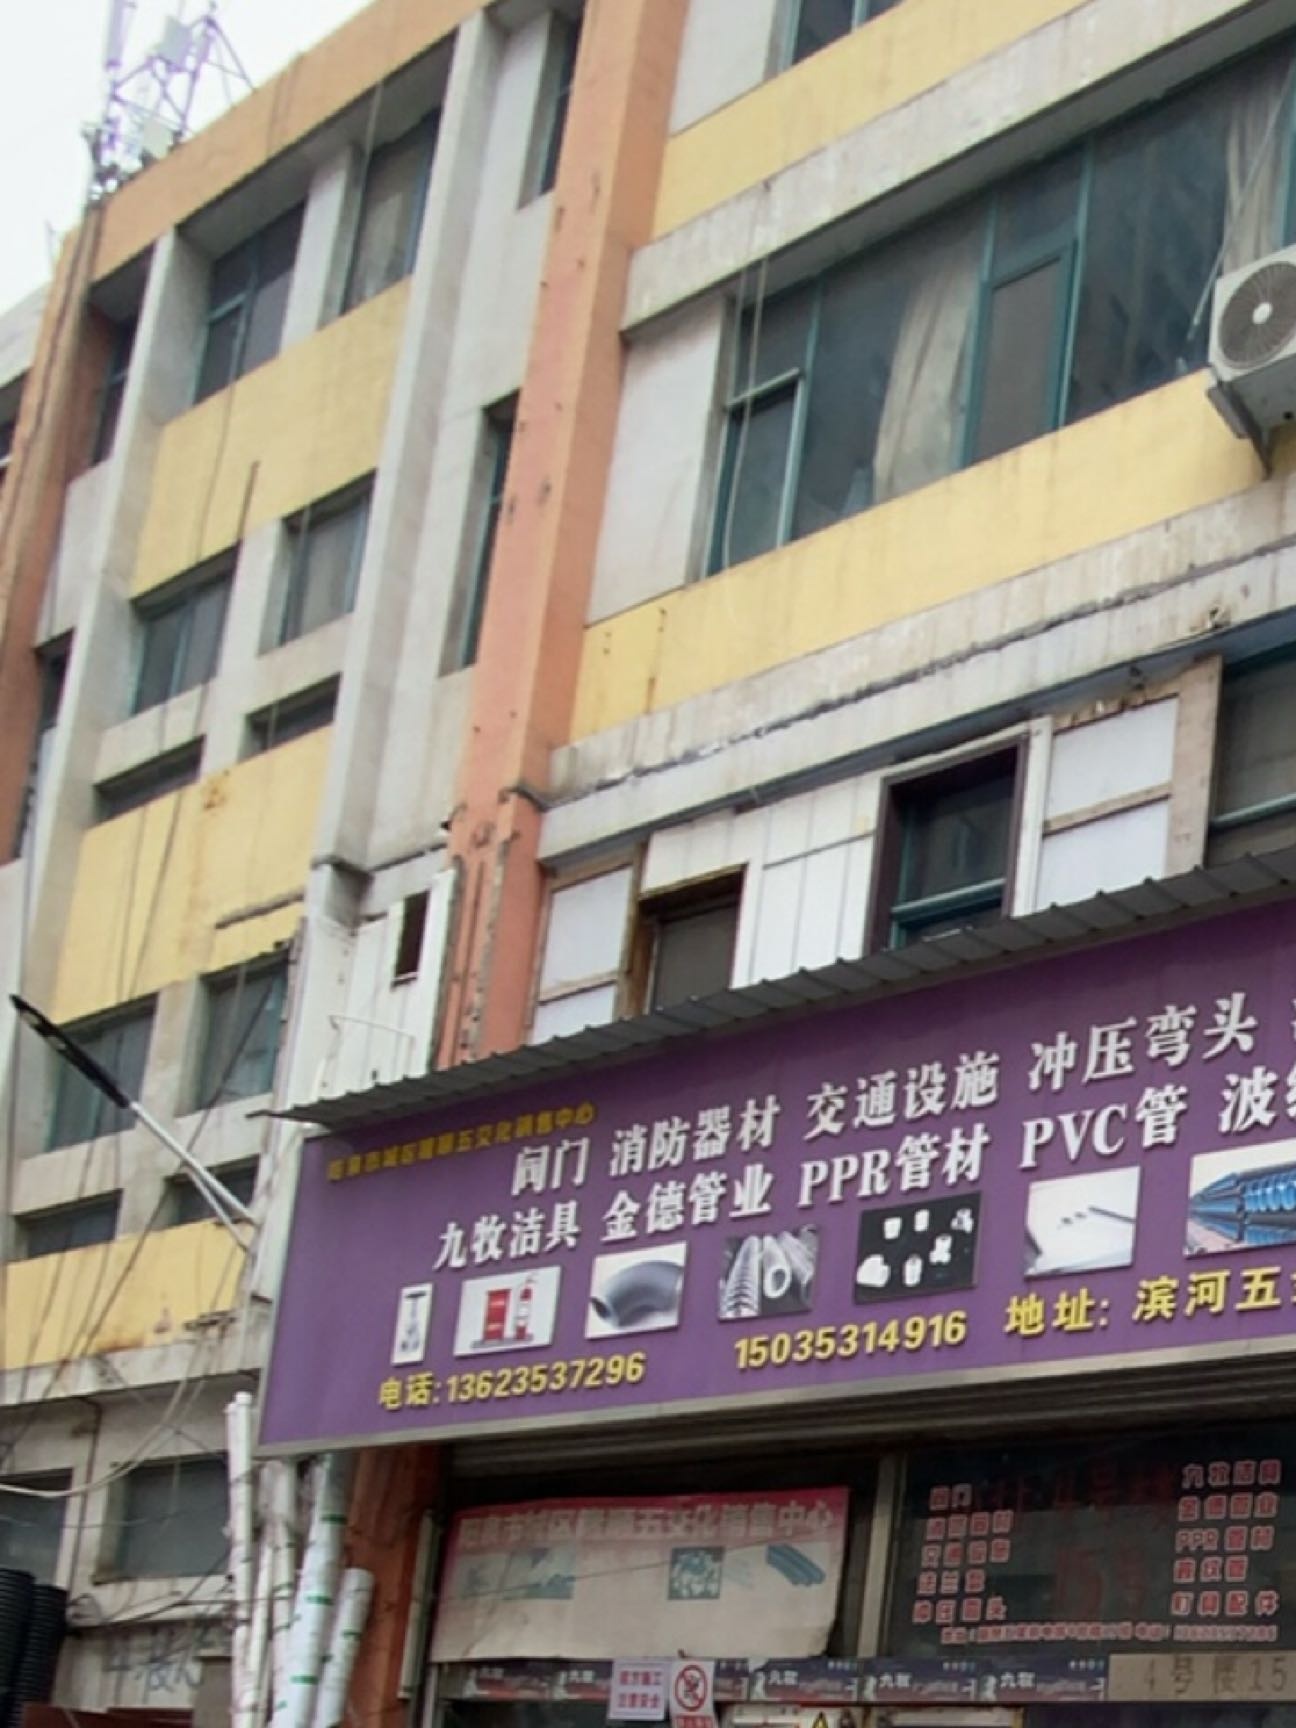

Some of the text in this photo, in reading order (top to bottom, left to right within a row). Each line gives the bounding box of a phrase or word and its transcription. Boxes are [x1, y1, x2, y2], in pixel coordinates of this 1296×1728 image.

[432, 1201, 581, 1270] 九牧洁具
[600, 1161, 773, 1243] 金德管业
[796, 1122, 989, 1208] PPR管材
[1018, 1082, 1190, 1170] PVC管
[608, 1095, 780, 1178] 消防器材
[804, 1050, 1001, 1141] 交通设施
[1028, 991, 1260, 1093] 冲压弯头
[733, 1310, 967, 1369] 15035314916
